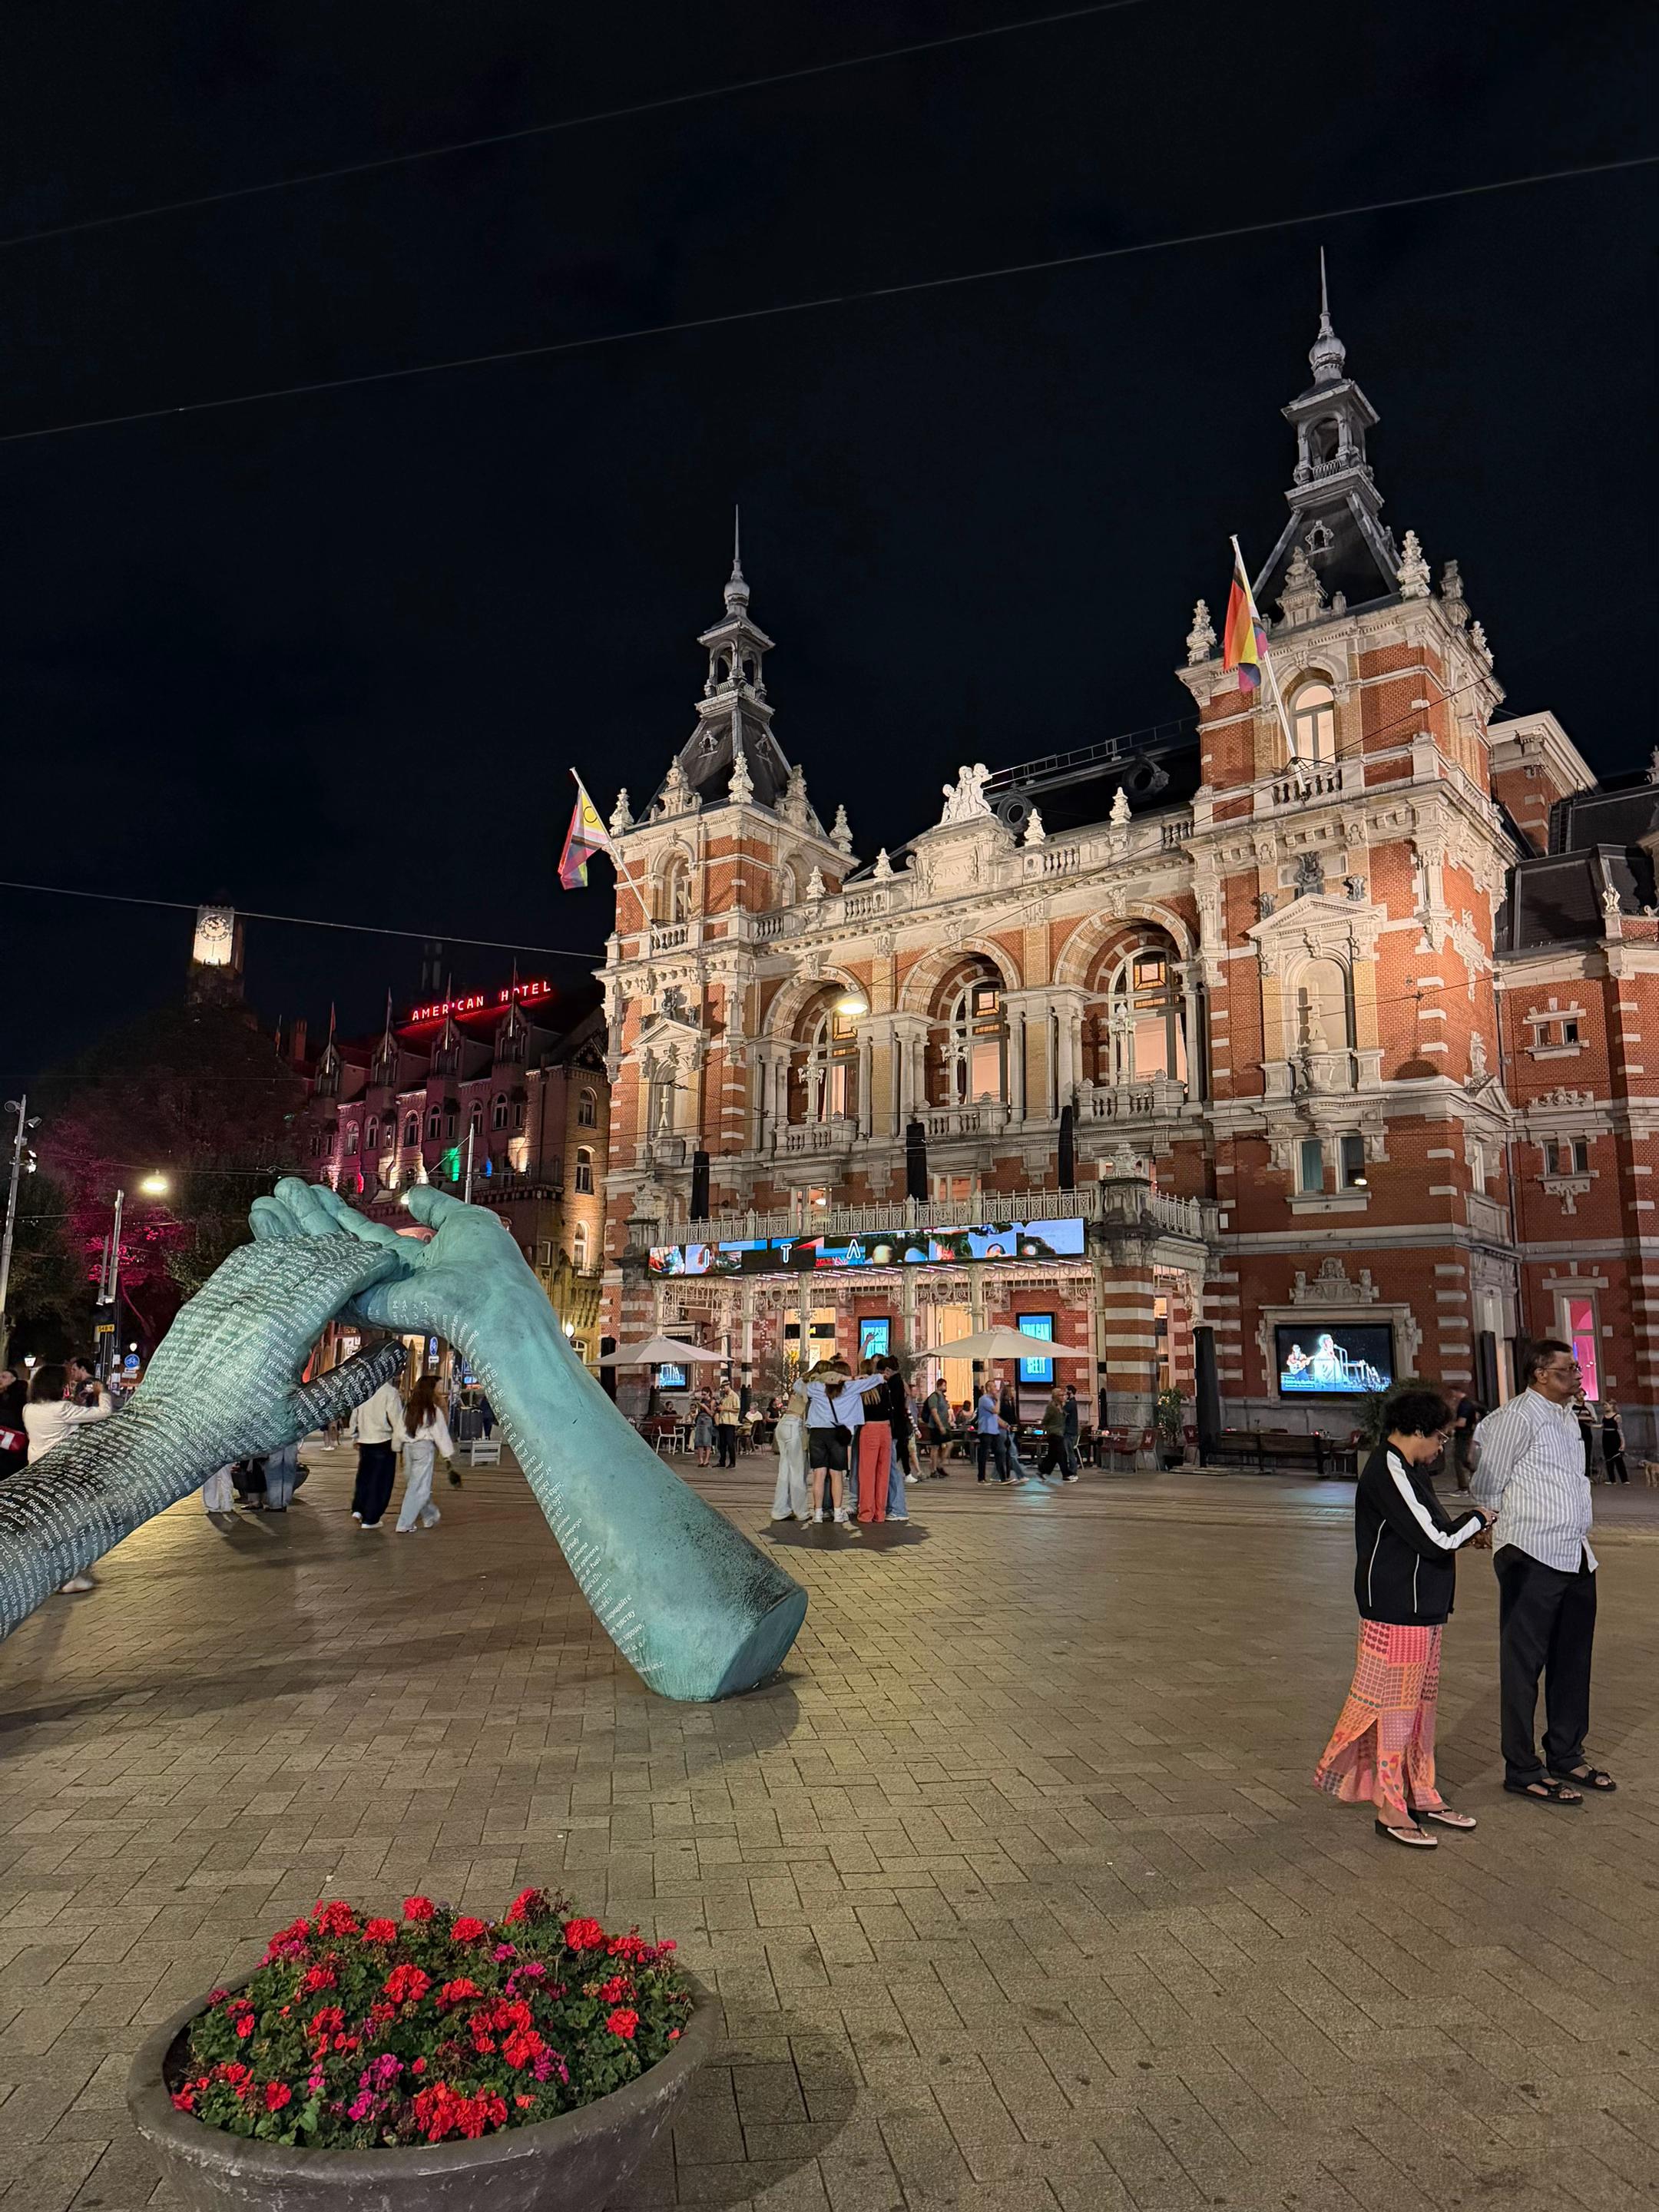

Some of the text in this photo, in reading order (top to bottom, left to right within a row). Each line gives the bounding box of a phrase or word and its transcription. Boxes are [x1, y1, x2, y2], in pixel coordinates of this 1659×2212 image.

[330, 1373, 343, 1388] con
[310, 1386, 321, 1398] de
[317, 1396, 327, 1406] la
[162, 1453, 174, 1467] kan
[141, 1488, 151, 1502] dyn
[54, 1490, 68, 1503] dir
[64, 1502, 82, 1527] selbst
[86, 1517, 95, 1532] sve
[88, 1501, 107, 1535] otvoreno
[11, 1492, 71, 1569] und folge deinem Gefühl
[18, 1506, 44, 1528] weiter.
[40, 1527, 55, 1550] Dann
[51, 1549, 61, 1567] wird
[62, 1521, 75, 1538] und
